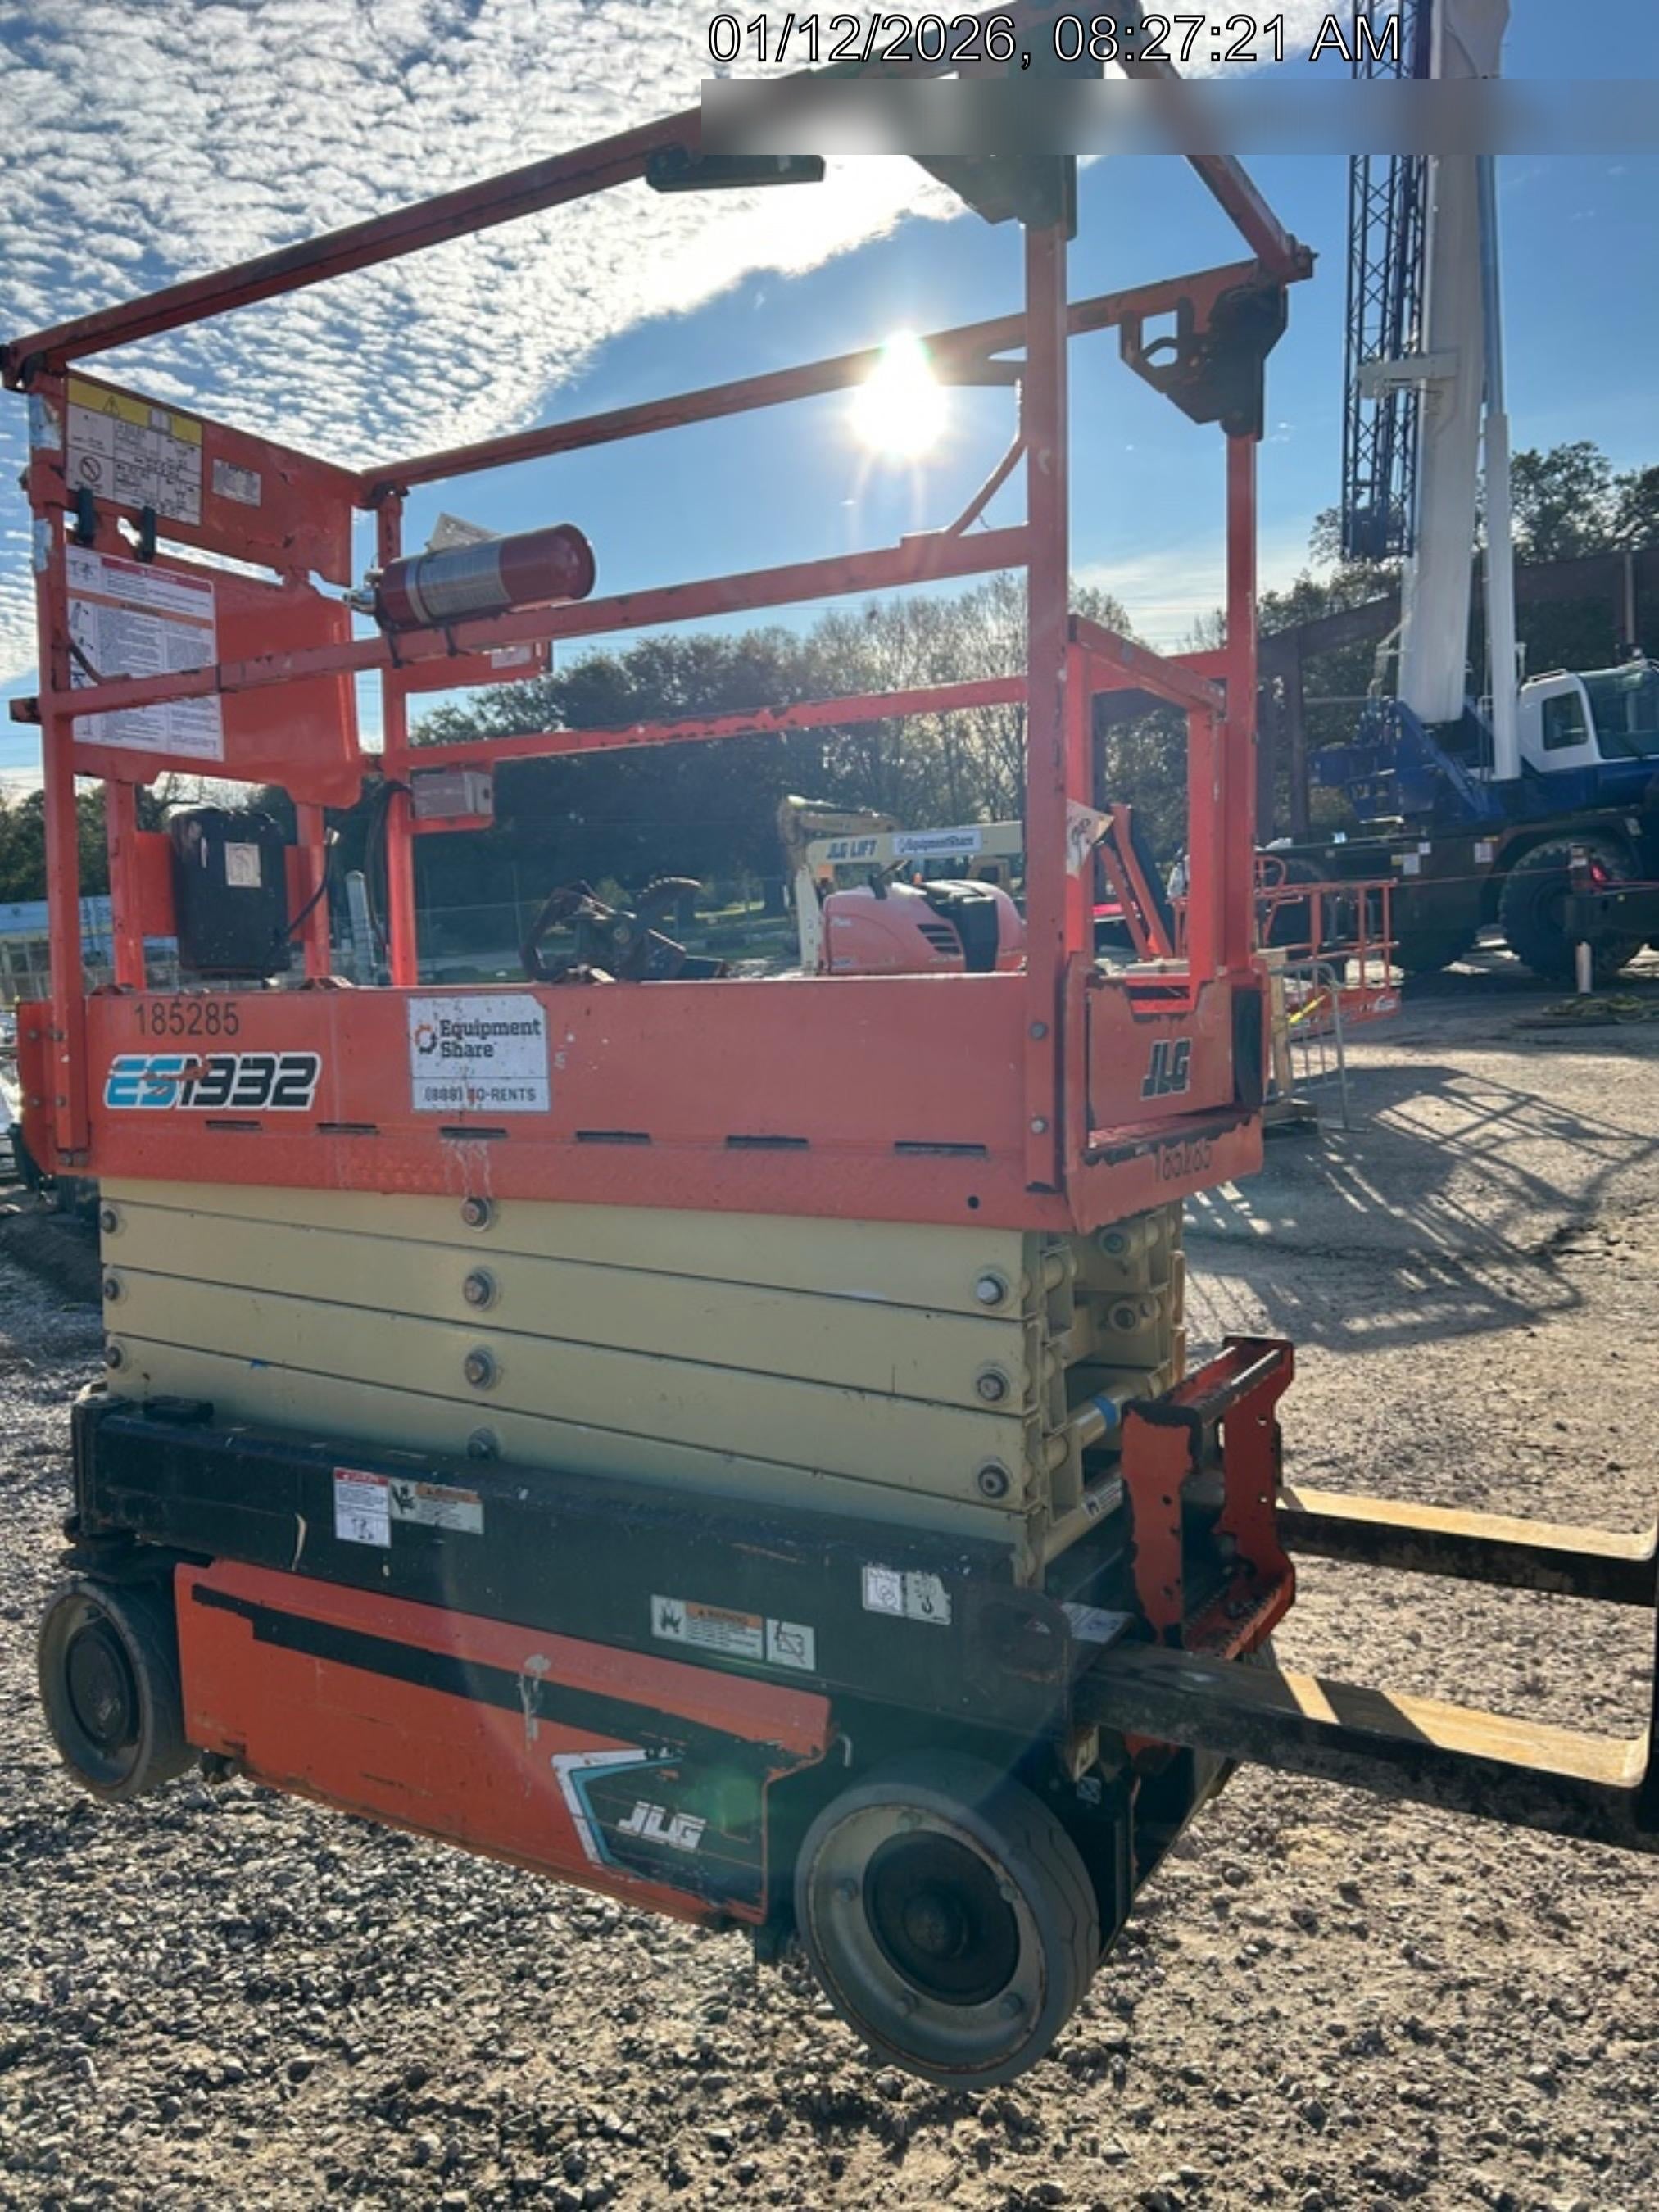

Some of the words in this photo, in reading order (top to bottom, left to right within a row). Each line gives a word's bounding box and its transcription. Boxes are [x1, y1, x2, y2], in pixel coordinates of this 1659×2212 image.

[850, 839, 878, 858] LIFT
[134, 1001, 239, 1036] 185285
[439, 1018, 542, 1040] Equipment
[441, 1041, 494, 1058] Share
[1140, 1036, 1193, 1101] JLG
[616, 1800, 708, 1853] JLG
